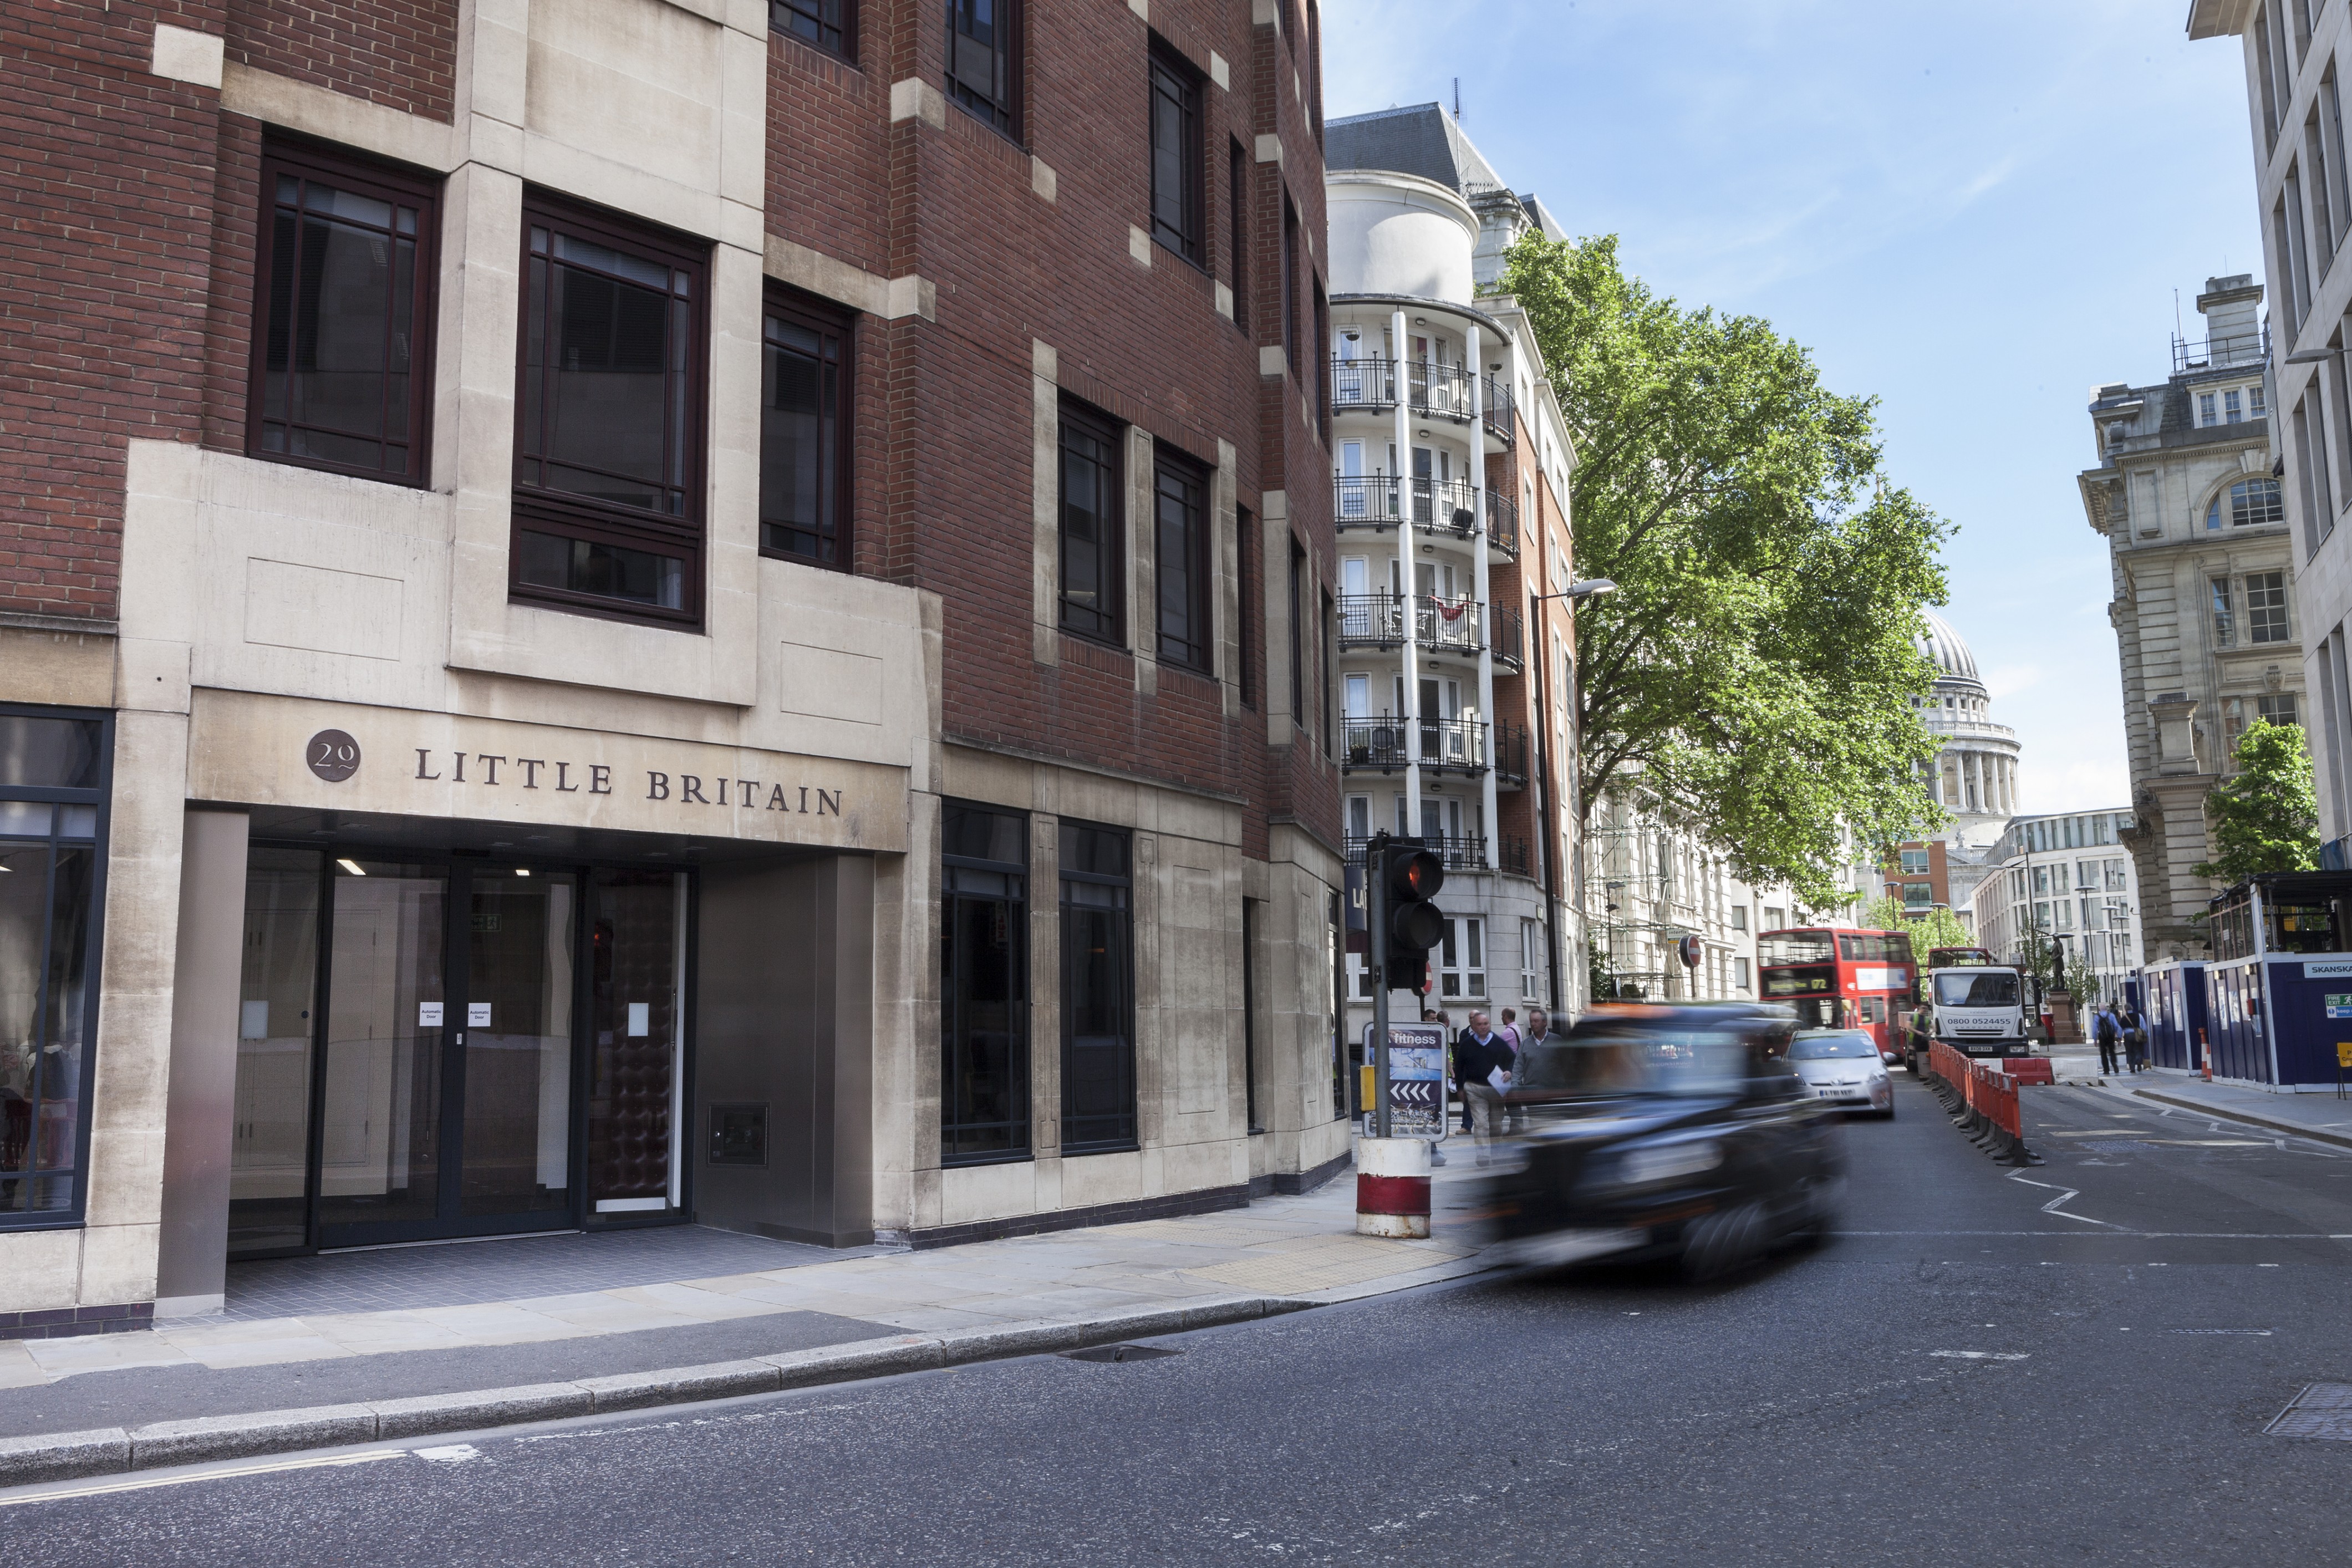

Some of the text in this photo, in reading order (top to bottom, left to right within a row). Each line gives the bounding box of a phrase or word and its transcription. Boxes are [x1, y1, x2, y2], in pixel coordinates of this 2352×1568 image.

[314, 741, 843, 817] 20 LITTLE BRITAIN
[1394, 1033, 1436, 1045] fitness
